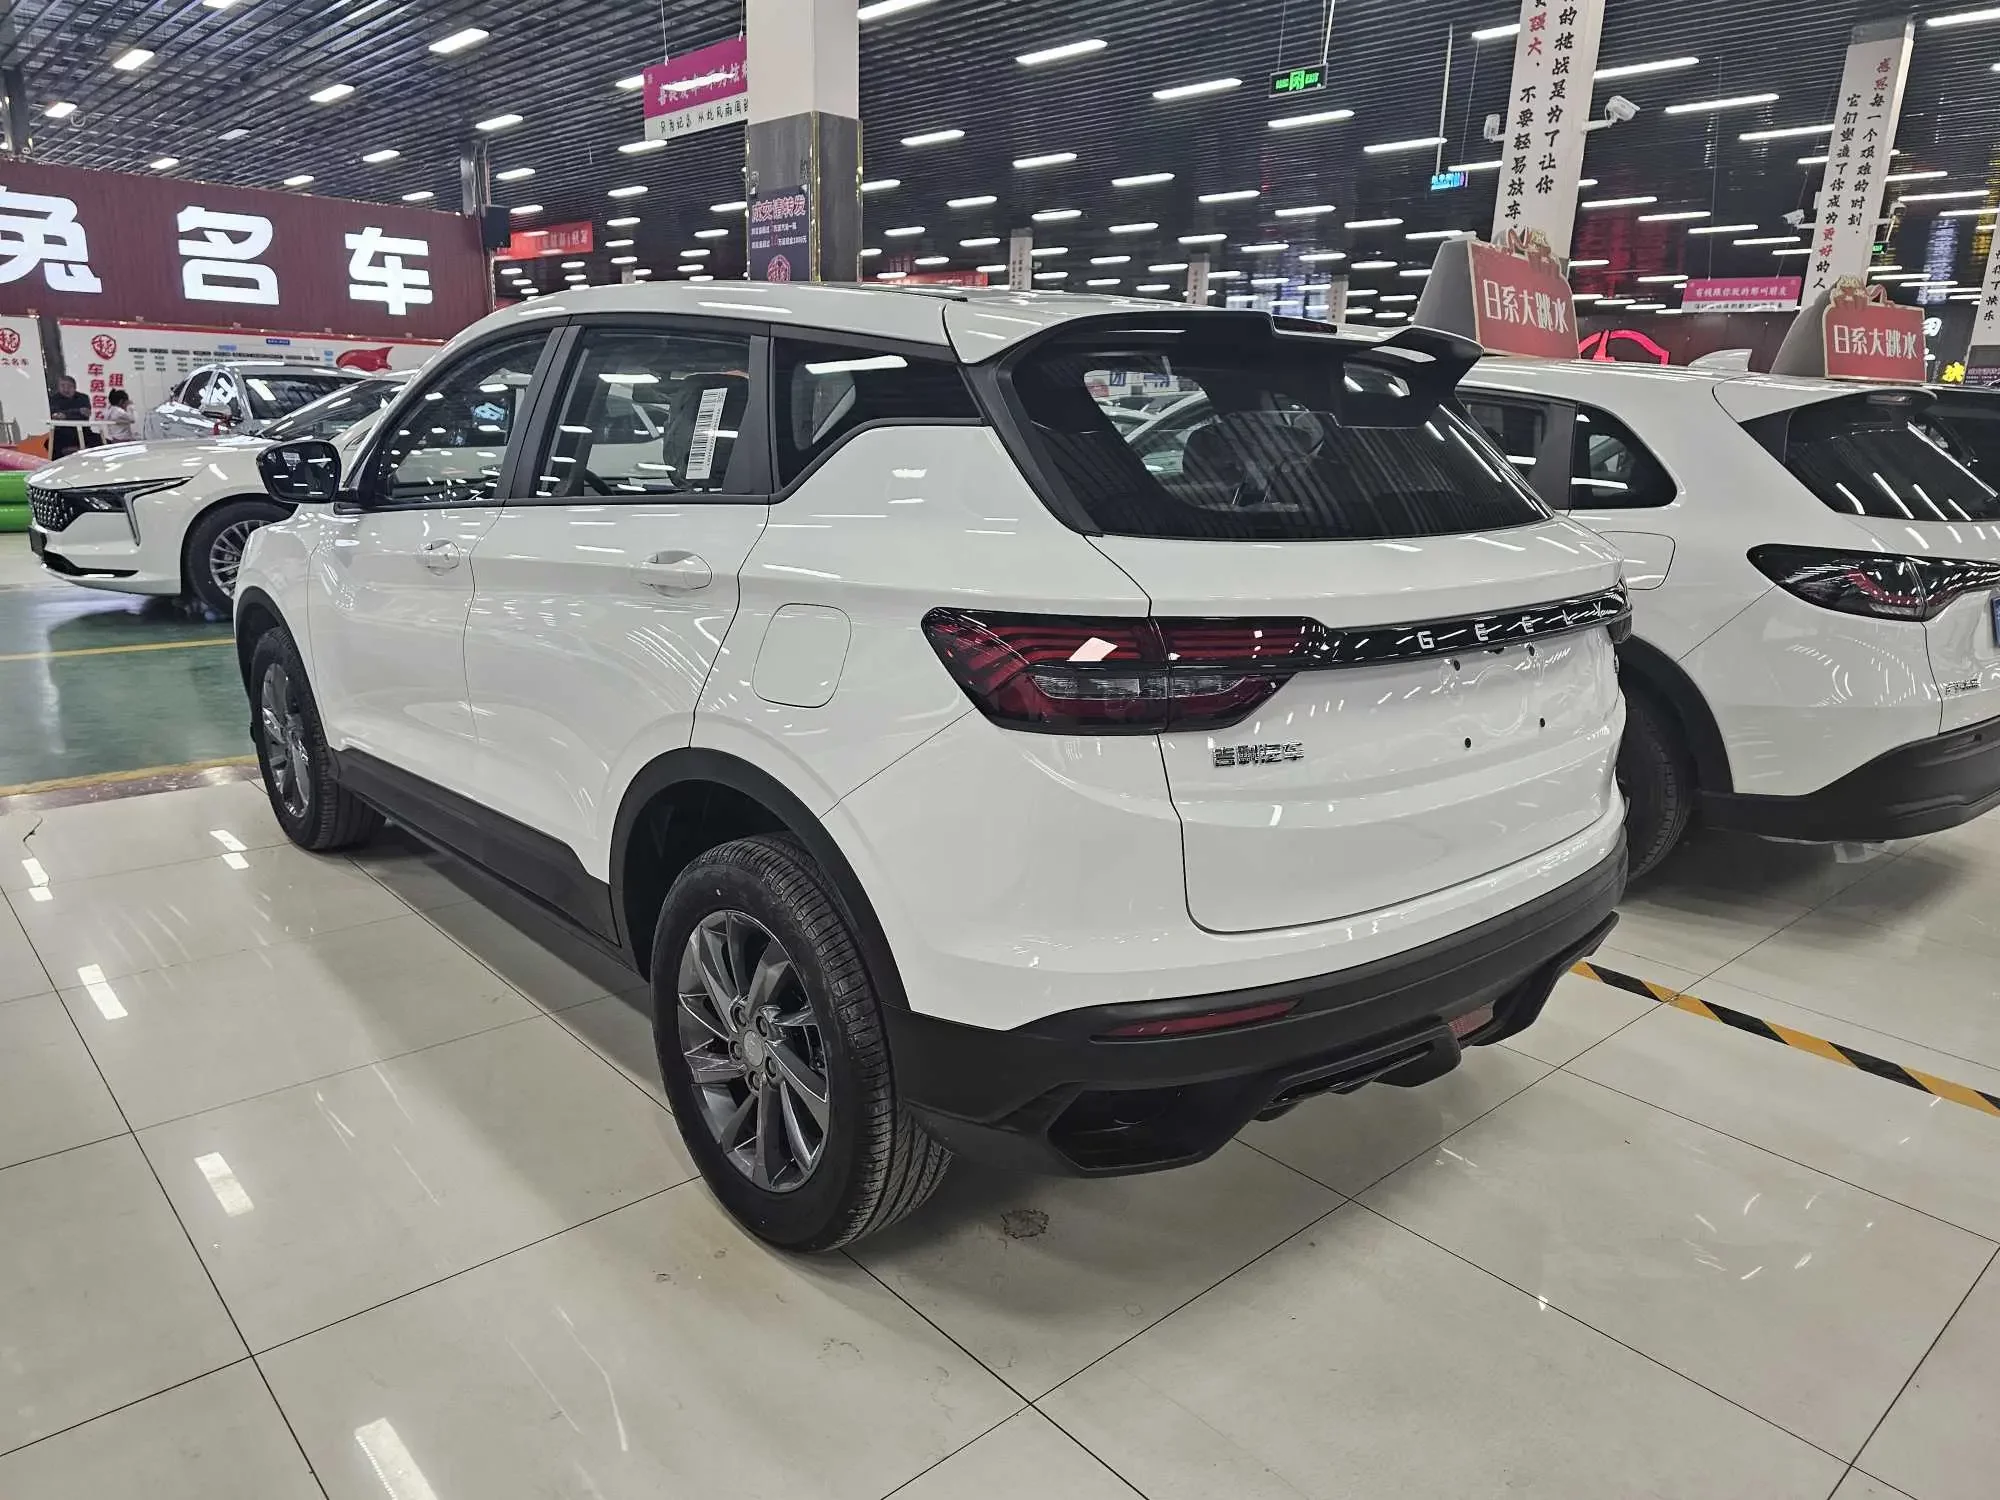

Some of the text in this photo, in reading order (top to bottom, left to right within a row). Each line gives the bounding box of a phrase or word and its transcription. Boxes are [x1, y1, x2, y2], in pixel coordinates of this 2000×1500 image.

[1536, 0, 1578, 194] 的挑战是为了让你
[0, 185, 434, 316] 兔名车
[1483, 278, 1569, 334] 日系大跳水
[1833, 324, 1918, 360] 日系大跳水
[1416, 602, 1605, 650] GEELY
[1213, 742, 1305, 767] 吉利汽车
